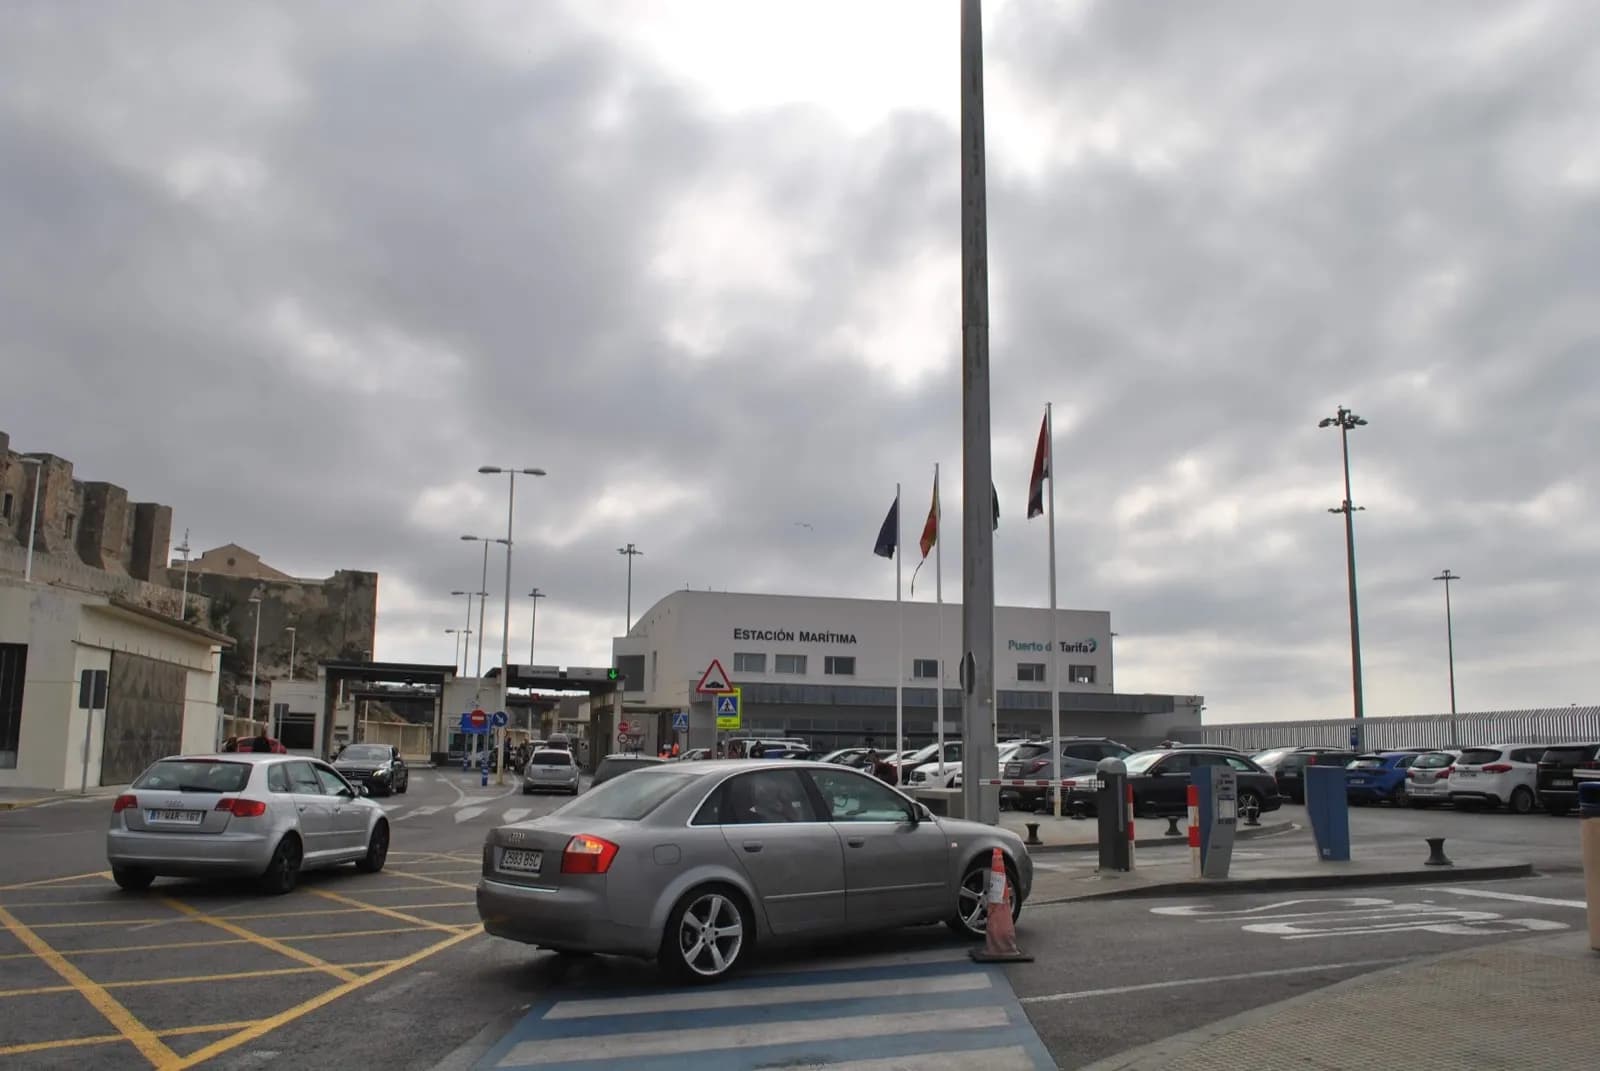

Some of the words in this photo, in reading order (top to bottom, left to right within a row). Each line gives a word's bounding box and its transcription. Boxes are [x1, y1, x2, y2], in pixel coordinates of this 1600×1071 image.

[733, 627, 795, 642] ESTACIÓN
[799, 630, 858, 644] MARÍTIMA
[1008, 639, 1044, 653] Puerto
[1059, 641, 1089, 653] Tarifa
